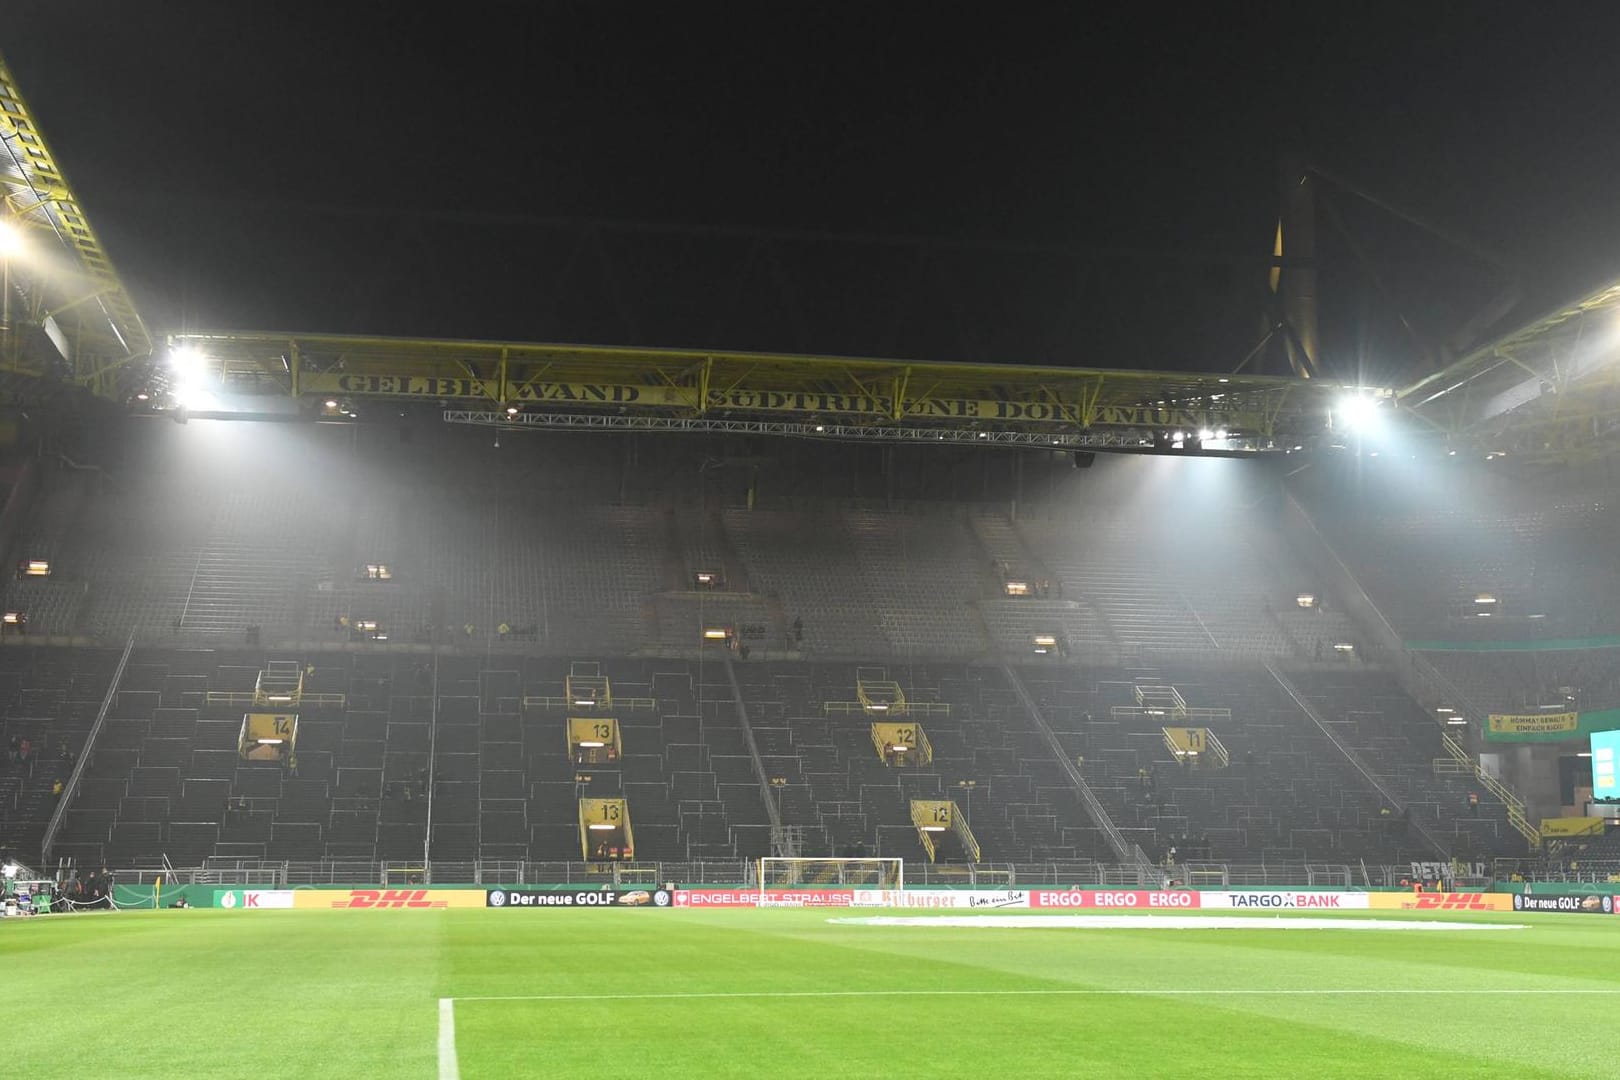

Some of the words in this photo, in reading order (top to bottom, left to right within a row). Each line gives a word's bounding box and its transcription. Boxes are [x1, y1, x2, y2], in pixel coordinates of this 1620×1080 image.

[339, 375, 486, 397] GELBE
[511, 382, 640, 402] WAND
[273, 719, 290, 735] 14
[593, 724, 610, 739] 13
[896, 728, 913, 744] 12
[601, 804, 619, 821] 13
[932, 807, 949, 822] 12
[1410, 862, 1485, 880] DETMLD
[349, 890, 433, 907] DHL
[510, 892, 535, 906] Der
[538, 894, 574, 906] neue
[576, 892, 615, 906] GOLF
[691, 892, 779, 904] ENGELBERT
[782, 892, 852, 904] STRAUSS
[881, 891, 956, 909] Biburger
[1039, 892, 1082, 906] ERGO
[1094, 892, 1137, 906] ERGO
[1149, 893, 1191, 906] ERGO
[1415, 893, 1488, 910] DHL
[1524, 896, 1538, 908] Der
[1538, 900, 1558, 909] neue
[1558, 897, 1581, 909] GOLF
